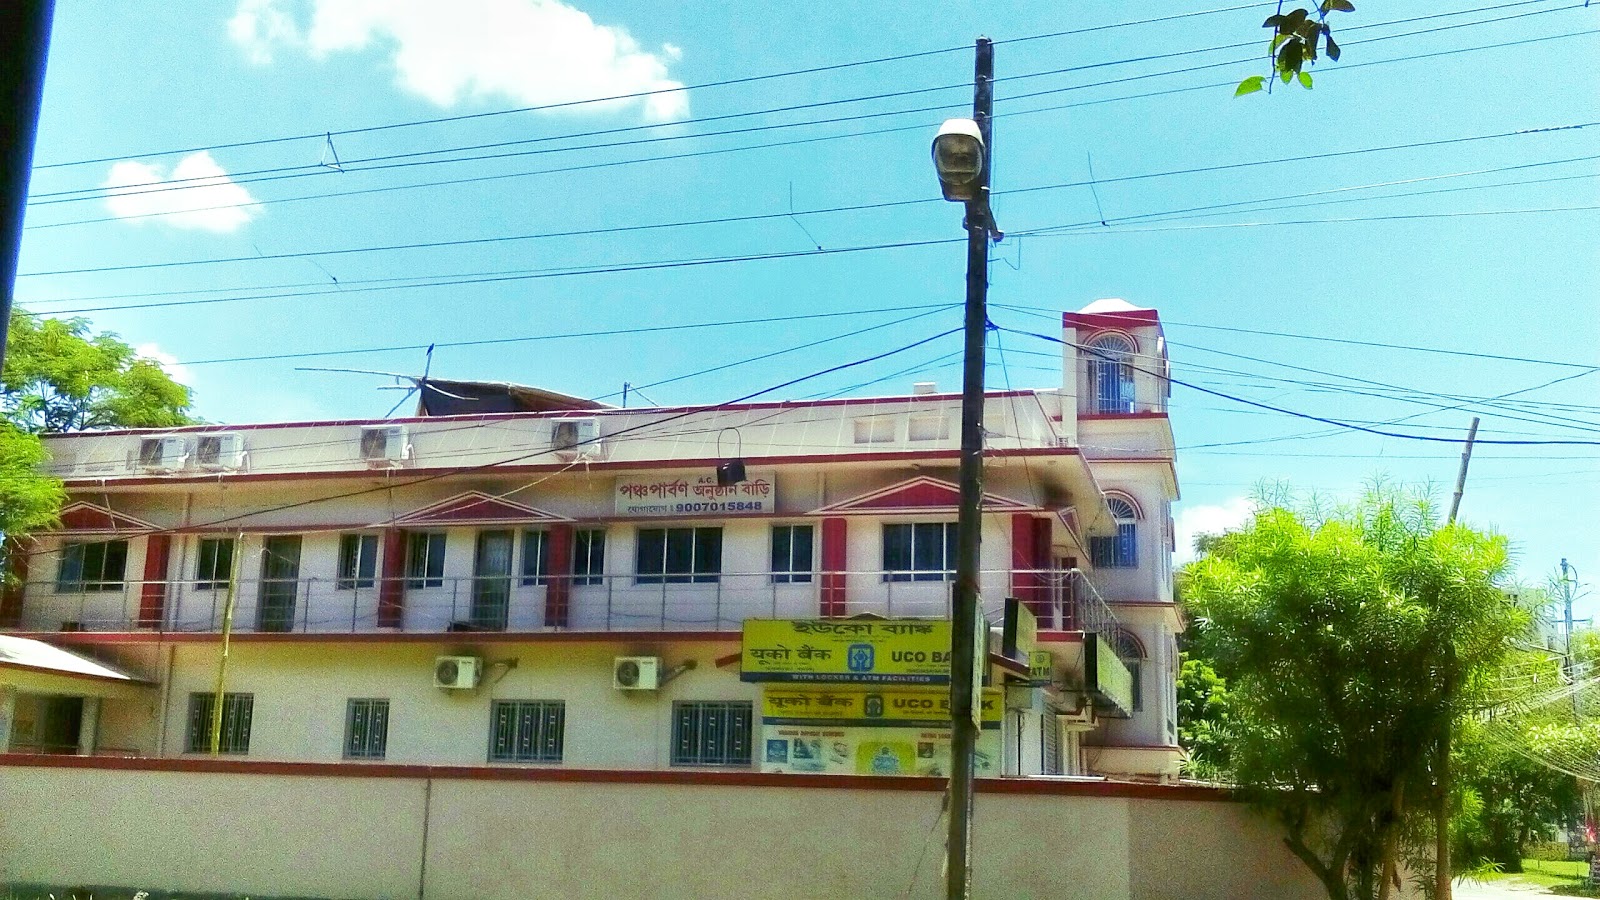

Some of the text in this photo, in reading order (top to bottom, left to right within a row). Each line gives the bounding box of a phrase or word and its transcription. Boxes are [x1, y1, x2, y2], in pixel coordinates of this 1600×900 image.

[675, 501, 762, 513] 9007015848
[750, 644, 833, 665] यूको बैंक
[891, 650, 951, 664] UCO BA
[892, 698, 935, 710] UCO
